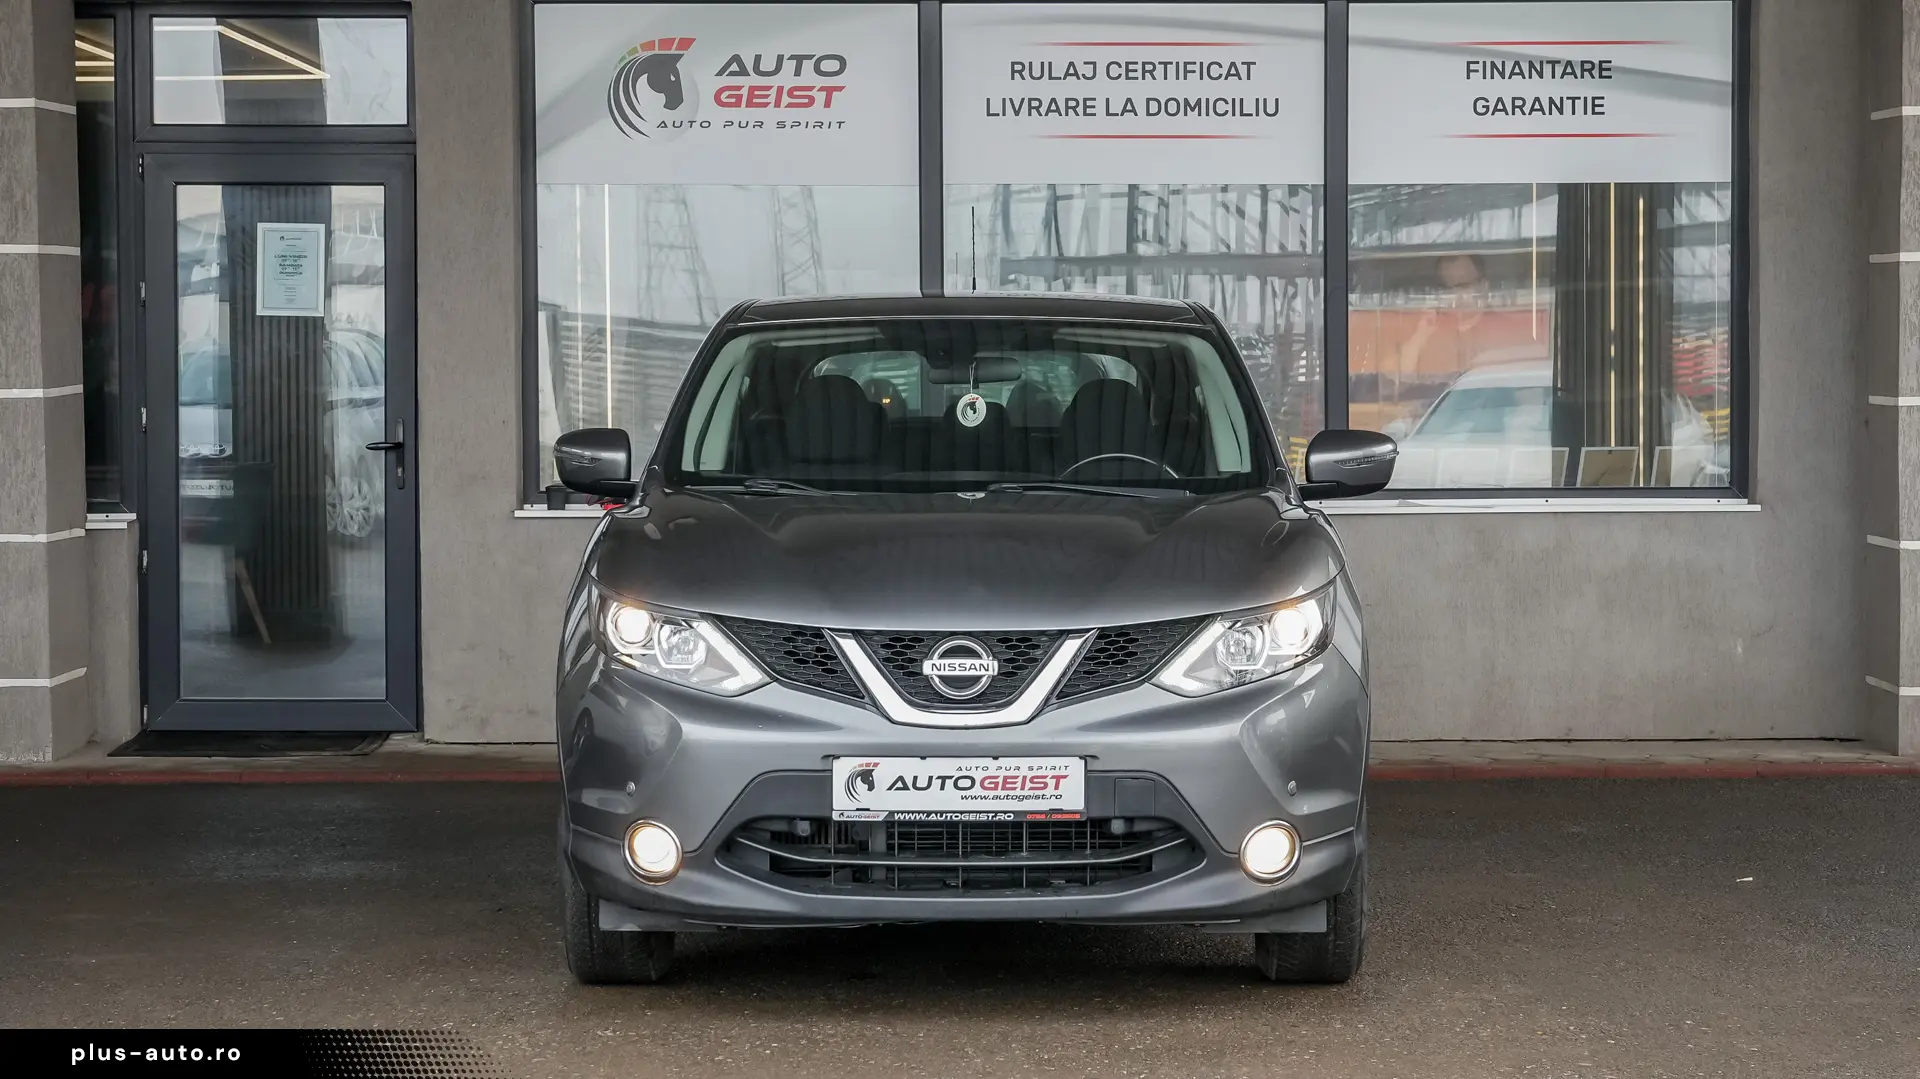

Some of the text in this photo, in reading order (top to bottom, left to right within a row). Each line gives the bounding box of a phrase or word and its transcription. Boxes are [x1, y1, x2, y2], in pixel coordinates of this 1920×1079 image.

[714, 54, 848, 78] AUTO
[1010, 60, 1257, 81] RULAJ CERTIFICAT
[1465, 60, 1613, 80] FINANTARE
[713, 85, 847, 109] GEIST
[986, 97, 1280, 117] LIVRARE LA DOMICILIU
[1472, 96, 1606, 116] GARANTIE
[656, 120, 846, 129] AUTO PUR SPIRIT
[931, 662, 990, 673] NISSAN
[885, 774, 1070, 792] AUTOGEIST
[960, 792, 1063, 803] www.autogeist.ro
[893, 812, 1015, 821] WWW.AUTOGEIST.RO
